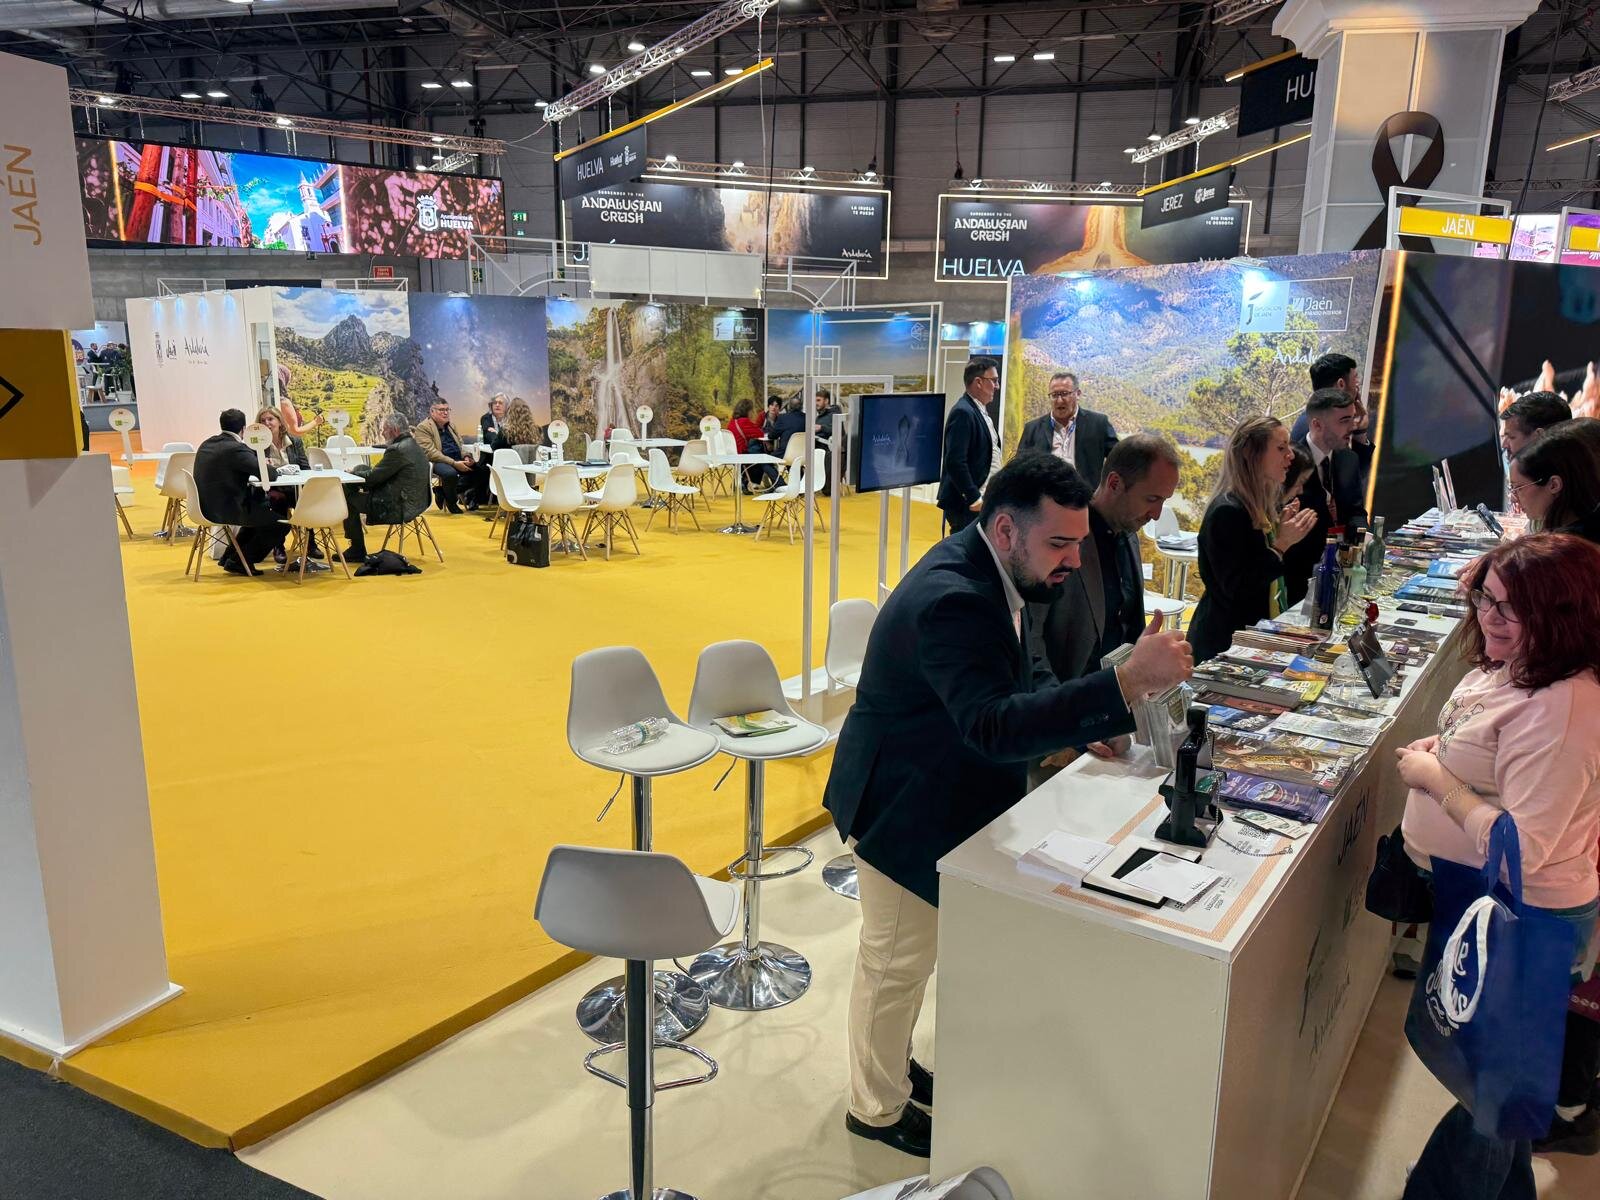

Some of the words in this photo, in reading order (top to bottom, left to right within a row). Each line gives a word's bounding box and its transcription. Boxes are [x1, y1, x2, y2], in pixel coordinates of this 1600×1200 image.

[576, 156, 604, 181] HUELVA
[0, 144, 42, 246] JAÉN
[1161, 193, 1184, 213] JEREZ
[581, 196, 662, 213] ANDALUSIAN
[440, 220, 475, 230] HUELVA
[600, 210, 644, 224] CRUSH
[954, 217, 1028, 231] ANDALUSIAN
[1441, 214, 1475, 236] JAÉN
[970, 230, 1010, 241] CRUSH
[942, 258, 1026, 278] HUELVA
[1305, 297, 1333, 311] Jaén
